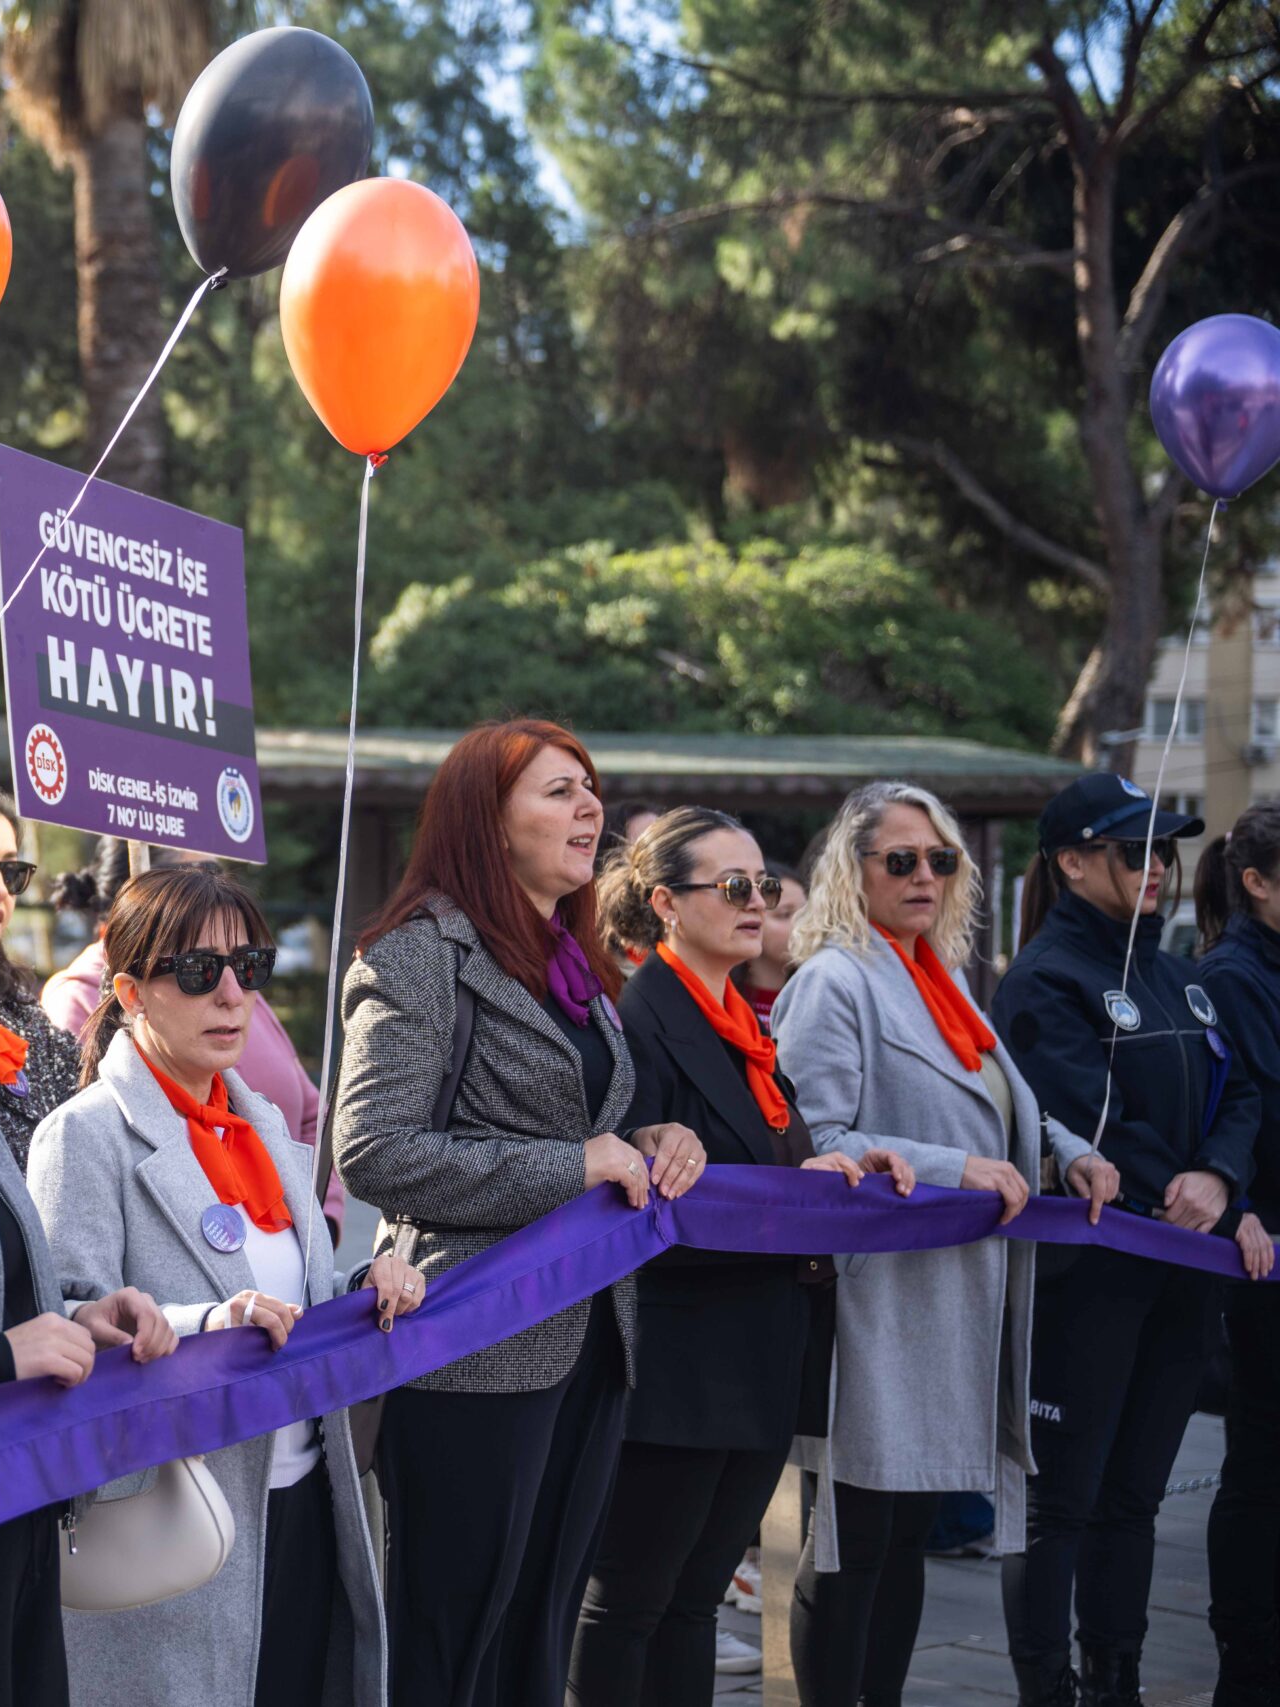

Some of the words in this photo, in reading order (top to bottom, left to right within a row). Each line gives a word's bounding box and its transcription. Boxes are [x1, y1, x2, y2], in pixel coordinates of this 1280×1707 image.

[39, 508, 174, 586] GÜVENCESİZ
[177, 548, 209, 598] İŞE
[40, 563, 112, 627] KÖTÜ
[116, 582, 214, 657] ÜCRETE
[47, 635, 217, 737] HAYIR!
[36, 752, 57, 772] DİSK
[88, 767, 116, 794] DİSK
[117, 776, 168, 808] GENEL-İŞ
[167, 782, 199, 811] İZMİR
[107, 803, 116, 823] 7
[154, 813, 186, 837] ŞUBE
[1030, 1399, 1061, 1423] BITA
